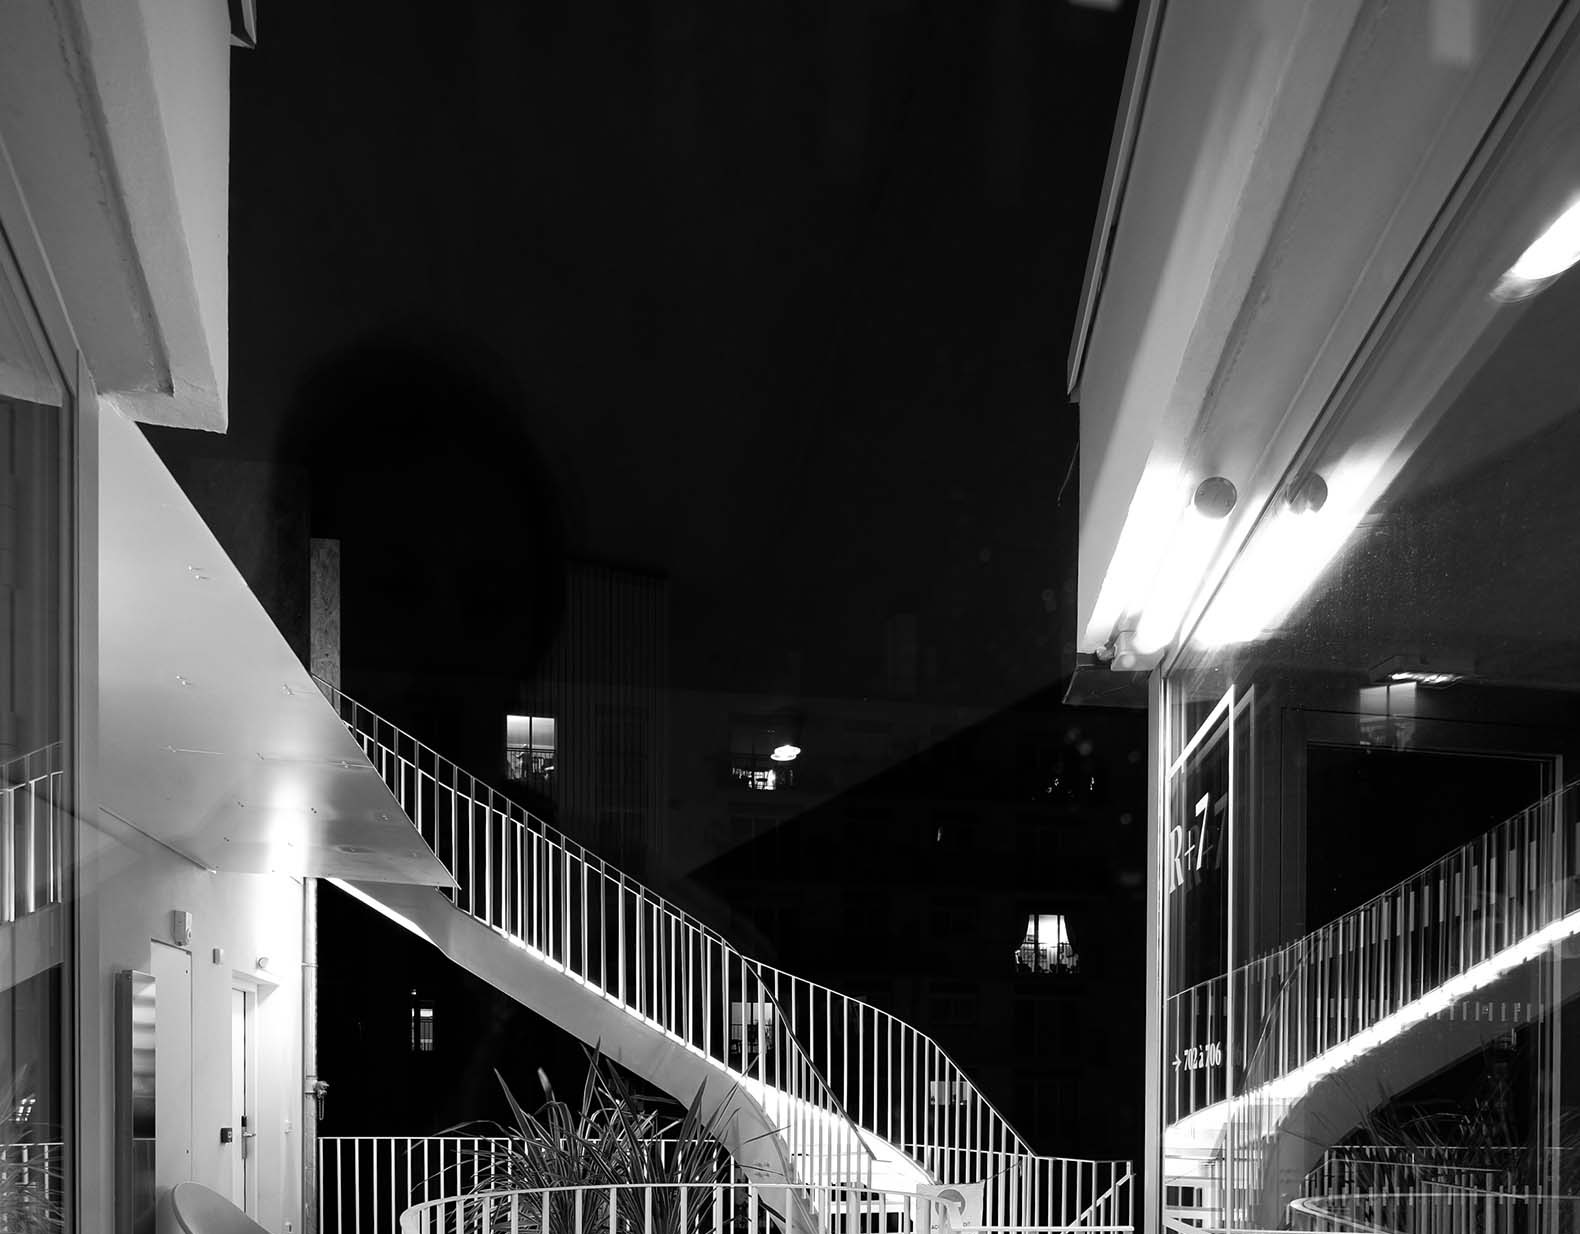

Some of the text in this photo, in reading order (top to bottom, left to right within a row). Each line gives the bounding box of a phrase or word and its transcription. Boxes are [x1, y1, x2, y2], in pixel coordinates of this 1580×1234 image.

[1169, 791, 1209, 894] R+7
[1184, 1041, 1221, 1071] 702 à 706
